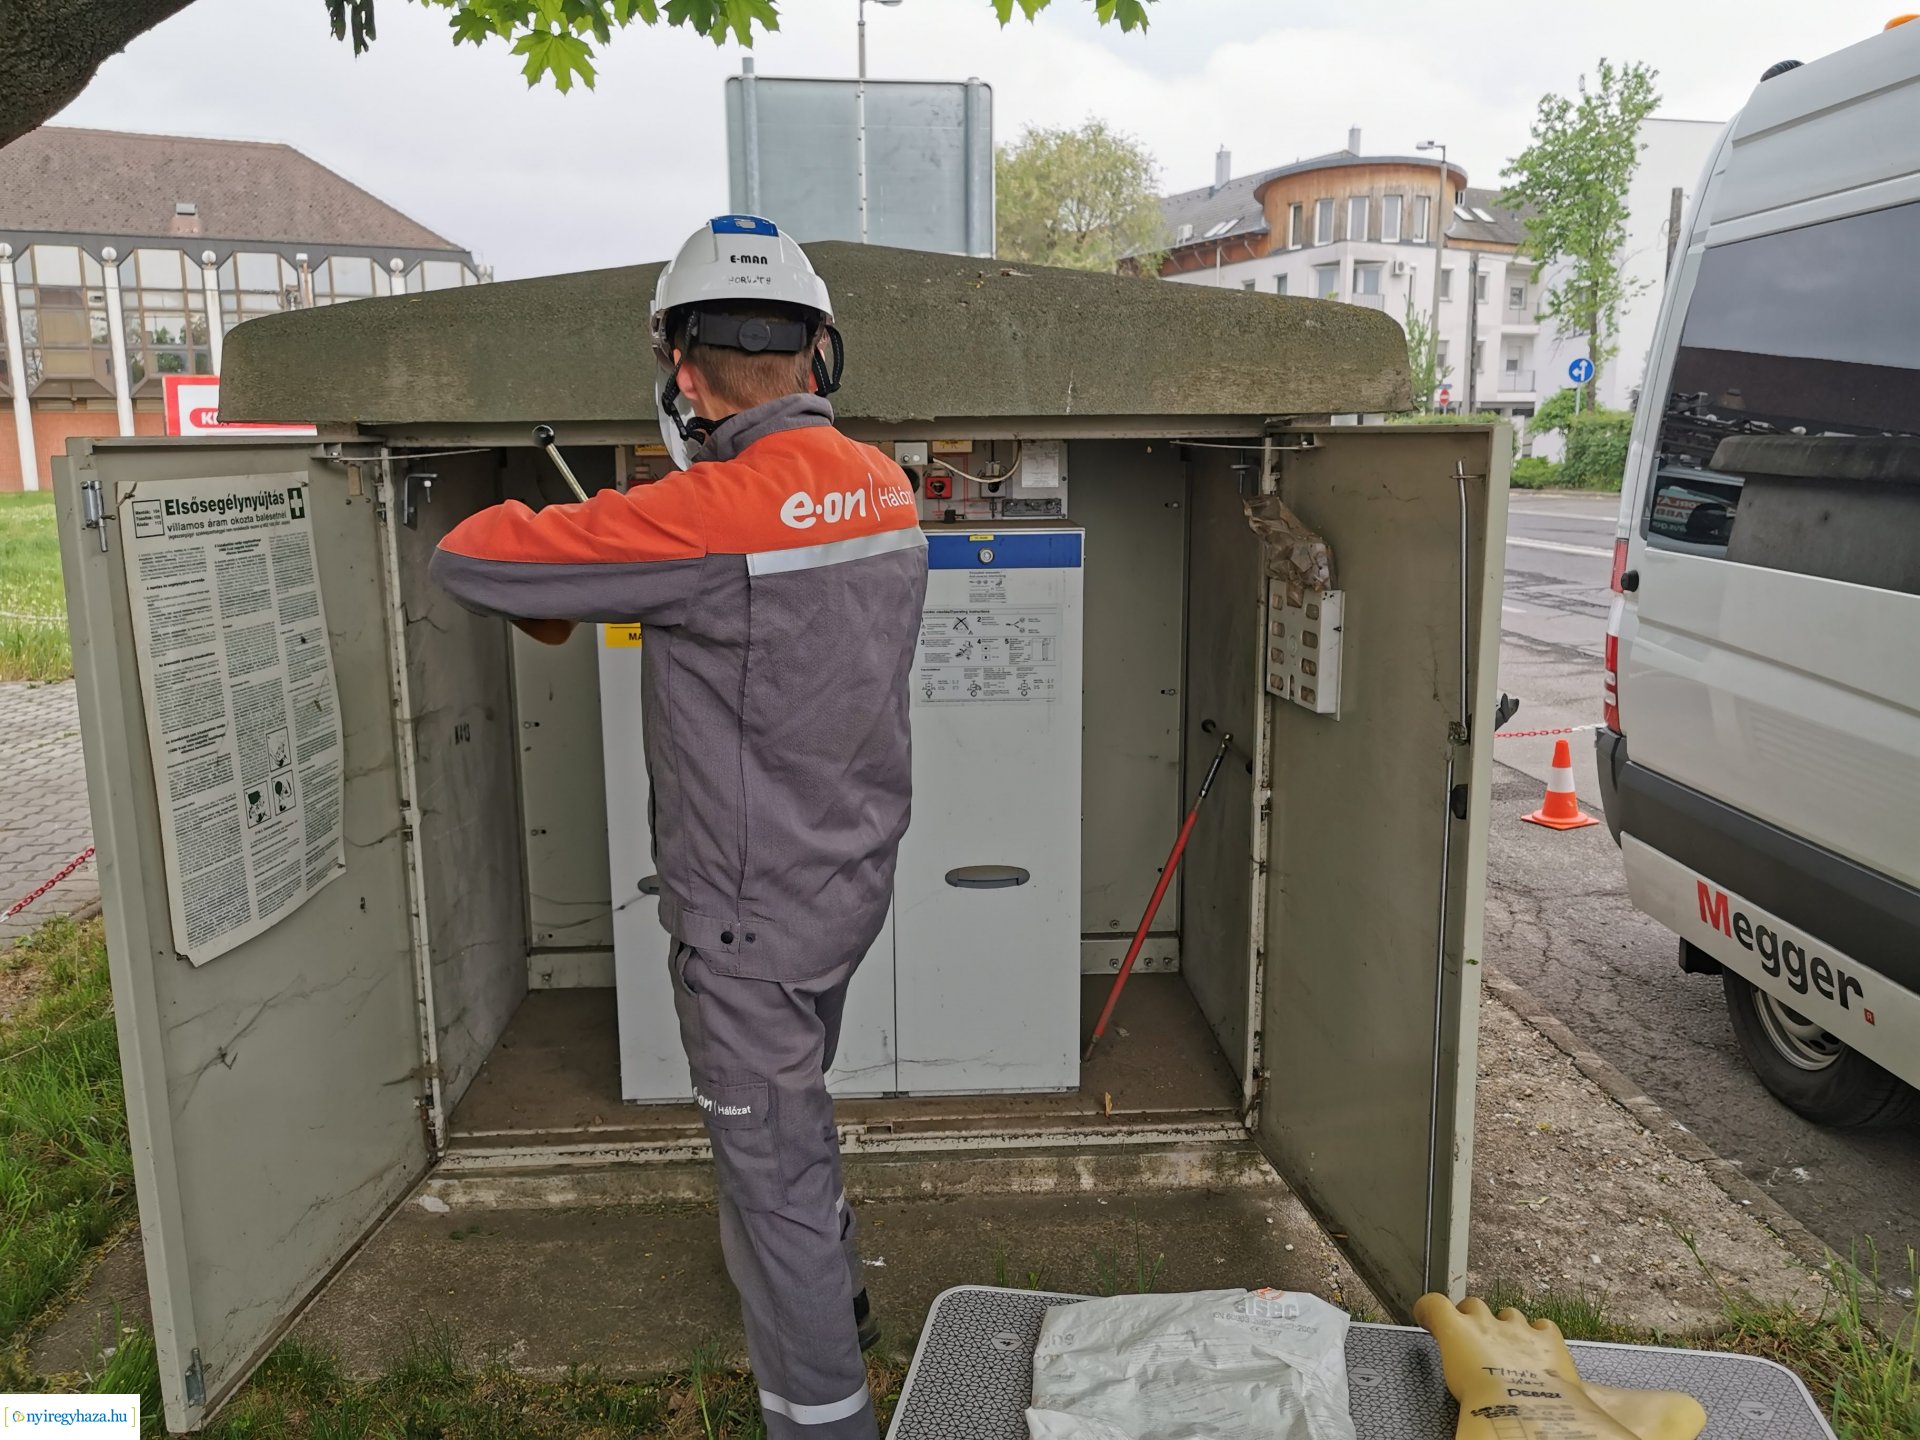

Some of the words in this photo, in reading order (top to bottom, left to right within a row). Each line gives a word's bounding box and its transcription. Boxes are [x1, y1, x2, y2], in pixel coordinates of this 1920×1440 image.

[729, 254, 768, 265] E-MAN
[164, 490, 285, 516] Elsősegélynyújtás
[167, 520, 205, 532] villamos
[208, 518, 228, 528] áram
[230, 515, 254, 525] okozta
[1696, 880, 1864, 1010] Megger
[717, 1105, 752, 1116] Hálózat
